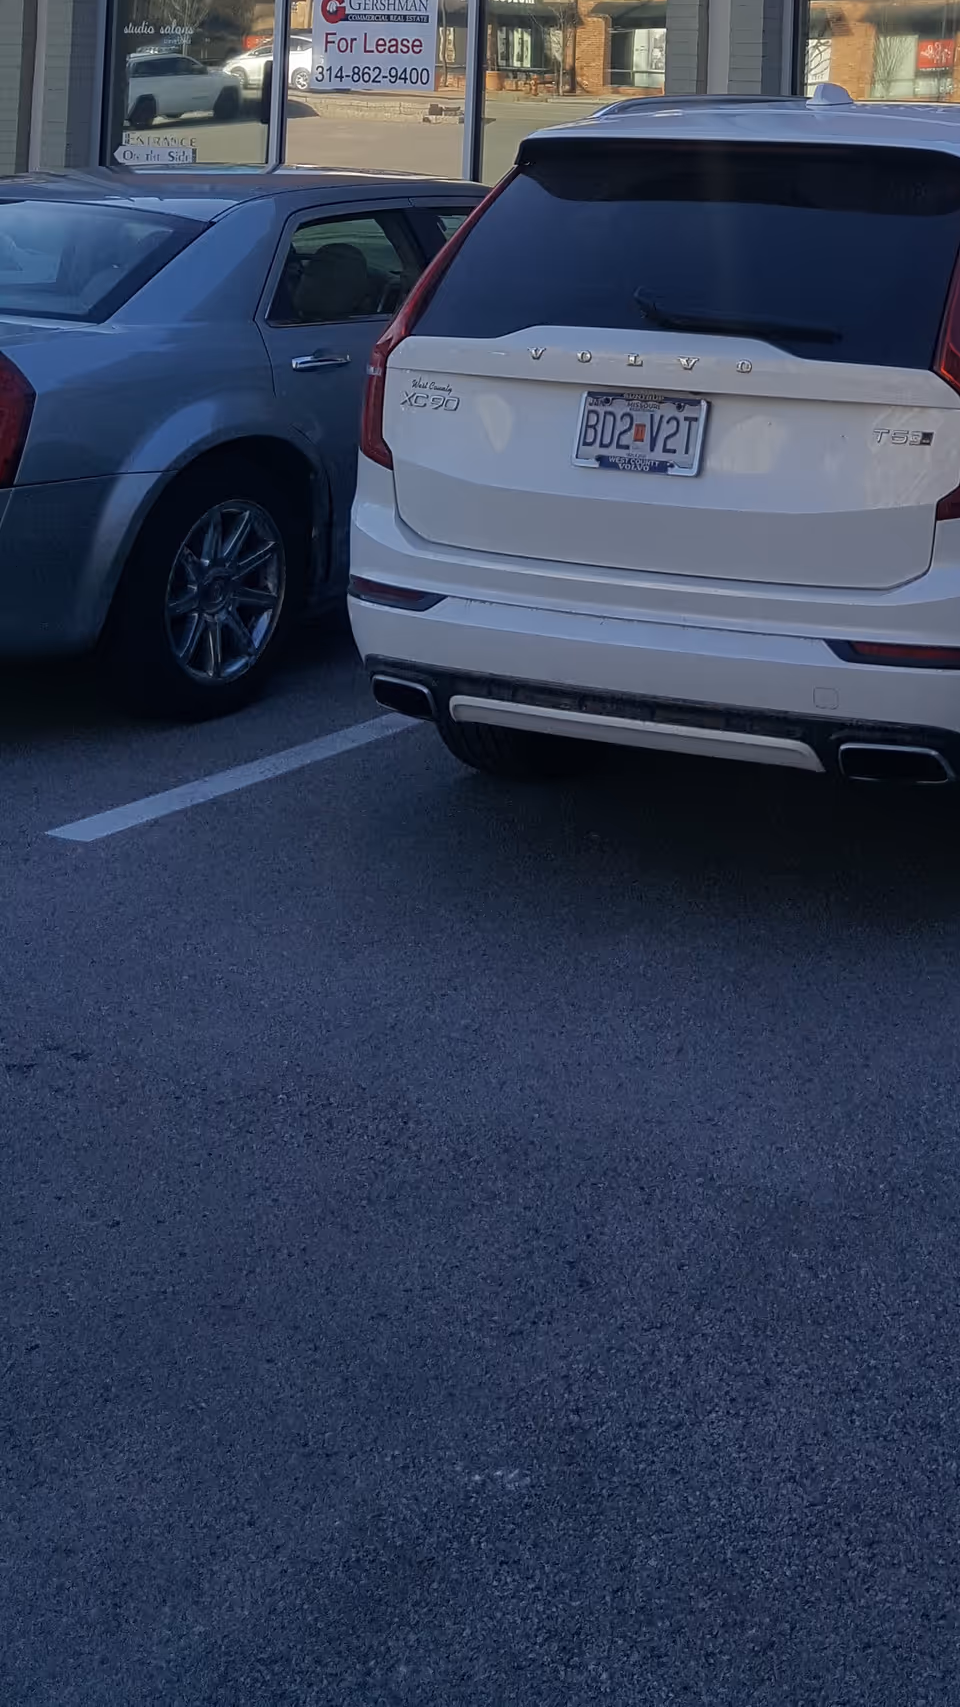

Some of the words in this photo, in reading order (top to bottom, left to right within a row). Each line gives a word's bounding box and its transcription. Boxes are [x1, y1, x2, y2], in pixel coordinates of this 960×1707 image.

[123, 20, 155, 34] studio
[347, 14, 389, 22] COMMERCIAL
[406, 15, 428, 23] ESTATE
[324, 32, 357, 53] For
[363, 32, 423, 54] Lease
[315, 65, 430, 86] 314-862-9400
[527, 347, 753, 374] VOLVO
[400, 390, 460, 412] XC90
[582, 409, 634, 451] BD2
[649, 413, 699, 455] V2T
[608, 455, 629, 465] WEST
[618, 463, 650, 472] VOLVO
